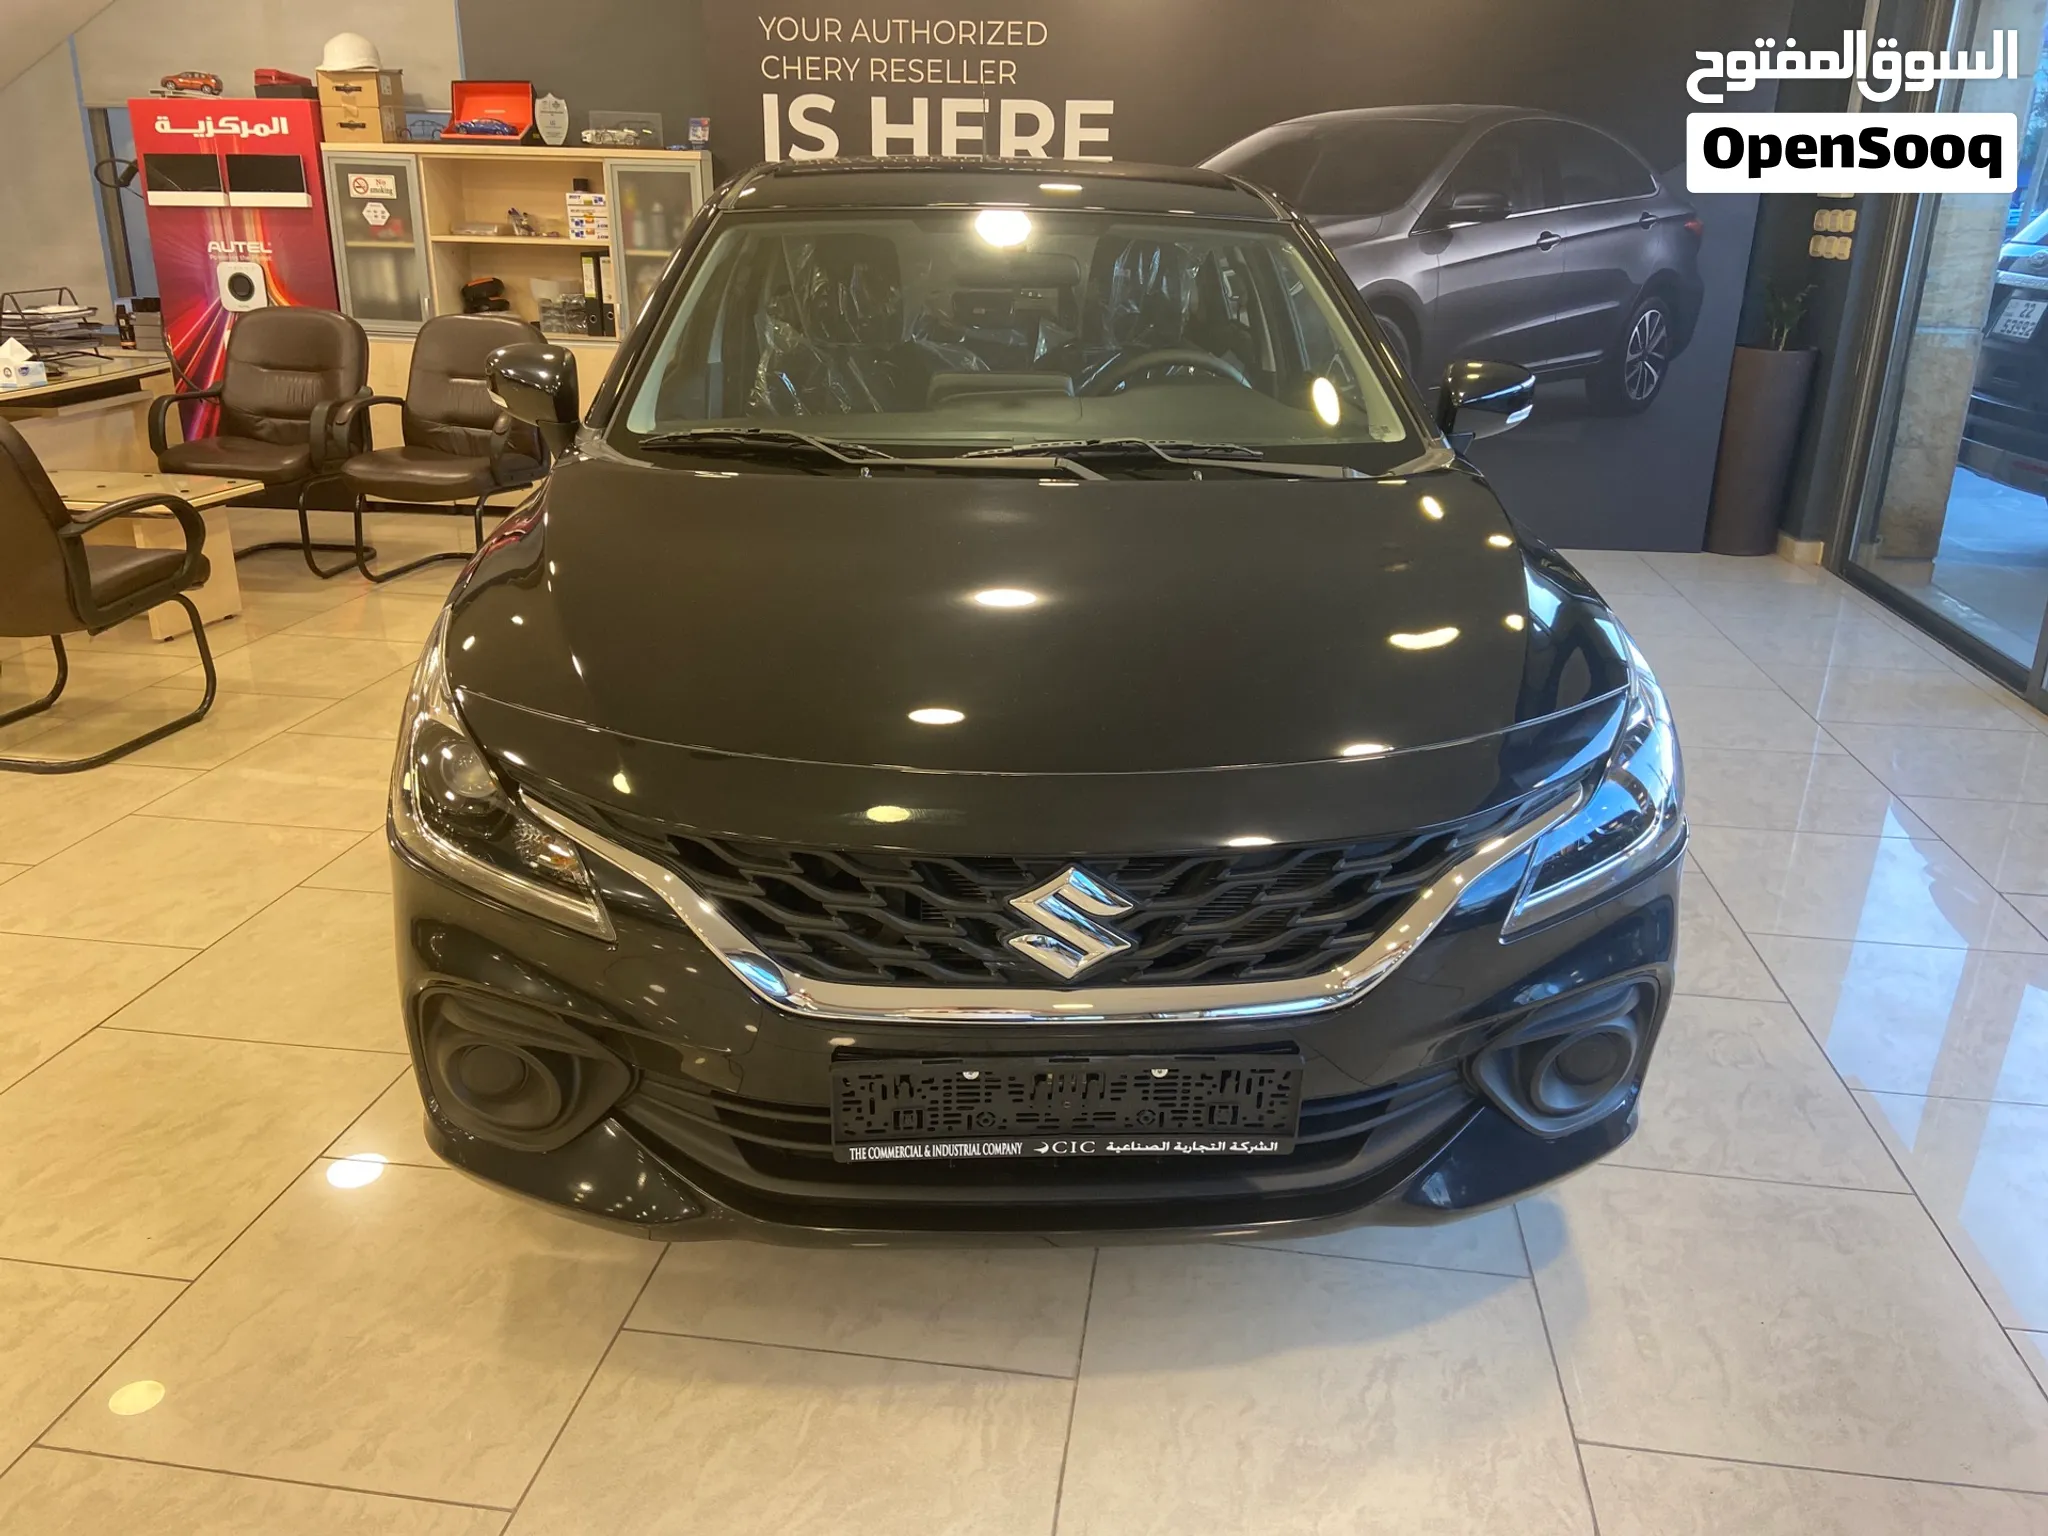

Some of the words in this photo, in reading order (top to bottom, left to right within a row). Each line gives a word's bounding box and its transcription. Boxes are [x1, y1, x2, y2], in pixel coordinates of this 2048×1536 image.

[758, 16, 842, 42] YOUR
[850, 19, 1049, 46] AUTHORIZED
[760, 55, 860, 81] CHERY
[869, 58, 1017, 85] RESELLER
[154, 115, 290, 139] المركزية
[762, 93, 840, 163] IS
[870, 96, 1114, 162] HERE
[207, 240, 273, 254] AUTEL
[849, 1147, 867, 1160] THE
[867, 1144, 924, 1160] COMMERCIAL
[923, 1144, 932, 1158] &
[932, 1142, 981, 1157] INDUSTRIAL
[982, 1141, 1023, 1156] COMPANY
[1051, 1140, 1096, 1154] CIC
[1105, 1141, 1171, 1154] الصناعية
[1173, 1141, 1226, 1154] التجارية
[1229, 1141, 1279, 1154] الشركة
